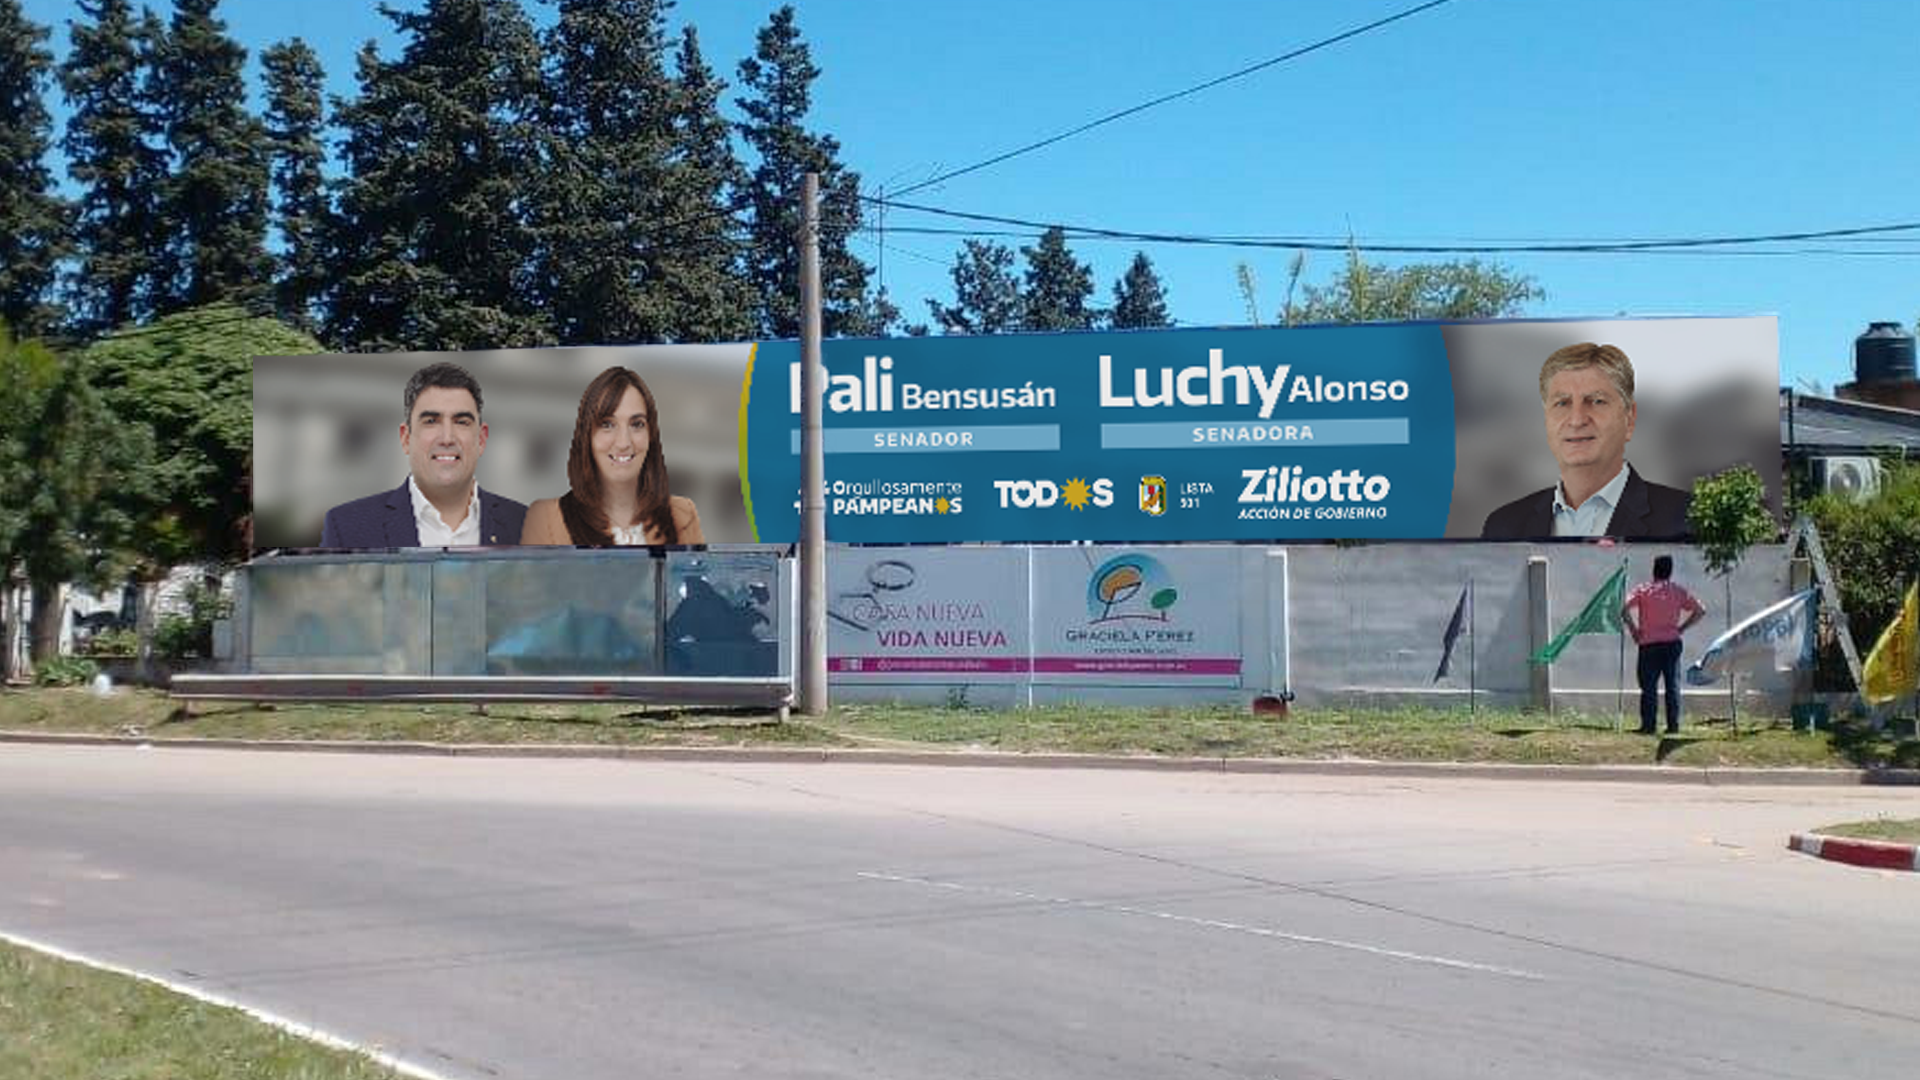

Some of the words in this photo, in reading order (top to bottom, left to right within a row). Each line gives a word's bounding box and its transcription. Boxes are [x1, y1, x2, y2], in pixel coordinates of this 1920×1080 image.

[1099, 348, 1291, 419] Luchy
[1288, 375, 1410, 403] Alonso
[902, 381, 1056, 410] Bensusán
[873, 432, 975, 448] SENADOR
[1192, 425, 1314, 443] SENADORA
[833, 479, 962, 500] Orgullosamente
[1180, 482, 1215, 495] LISTA
[1237, 465, 1391, 502] Ziliotto
[1237, 506, 1290, 519] ACCIÓN
[1292, 507, 1312, 519] DE
[1314, 506, 1388, 519] GOBIERNO
[916, 603, 985, 621] NUEVA
[877, 629, 928, 647] VIDA
[934, 629, 1007, 647] NUEVA
